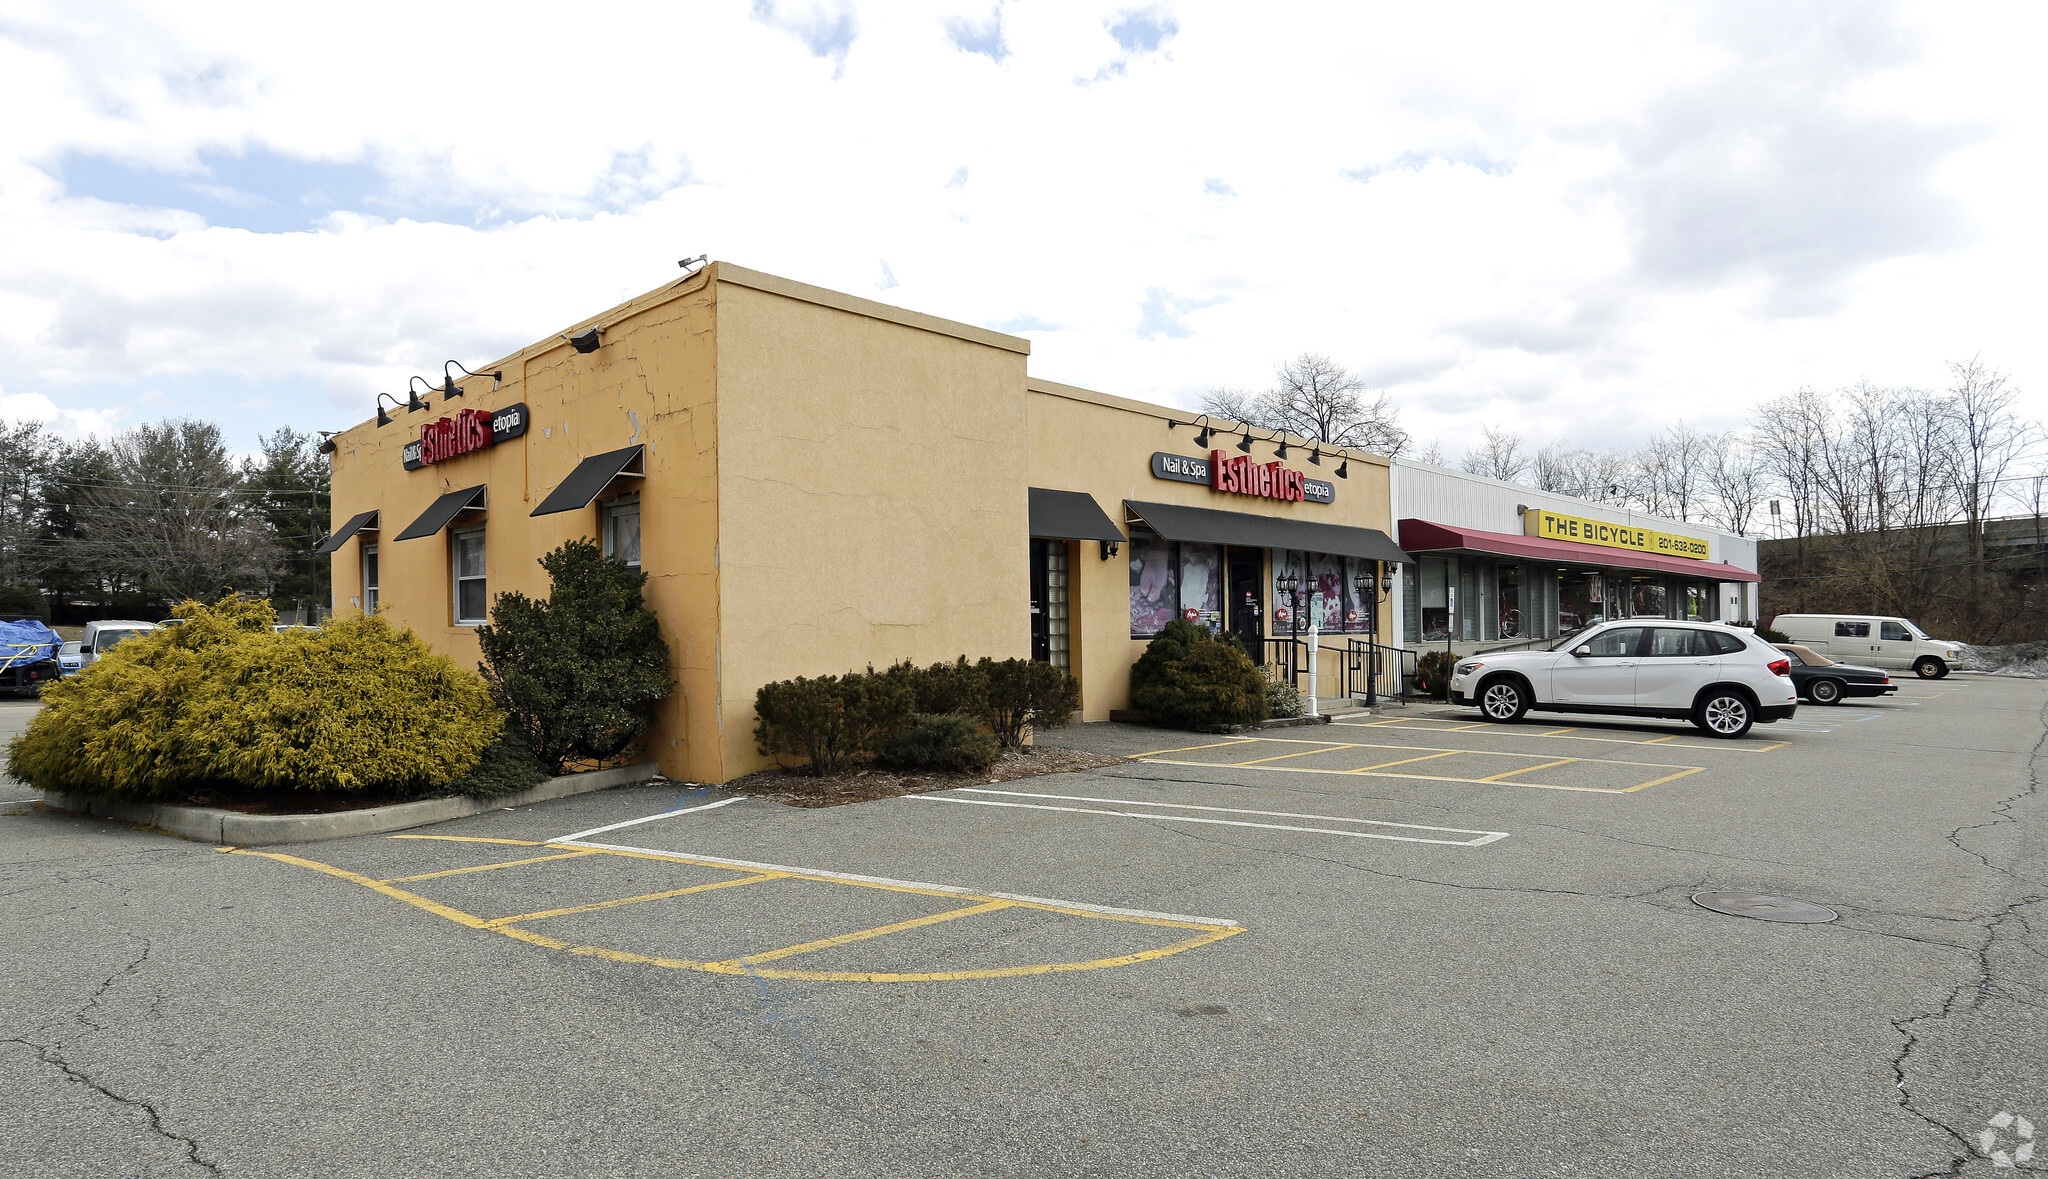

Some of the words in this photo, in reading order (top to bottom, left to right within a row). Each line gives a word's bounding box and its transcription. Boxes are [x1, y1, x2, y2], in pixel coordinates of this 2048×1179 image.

[421, 408, 488, 465] Esthetics
[493, 409, 520, 433] etopia
[1163, 456, 1181, 474] Nail
[1182, 460, 1190, 475] &
[1190, 461, 1207, 480] Spa
[1213, 449, 1305, 502] Esthetics
[1304, 482, 1330, 499] etopia
[1545, 516, 1578, 537] THE
[1584, 523, 1645, 547] BICYCLE
[1658, 537, 1707, 555] 201-632-0200
